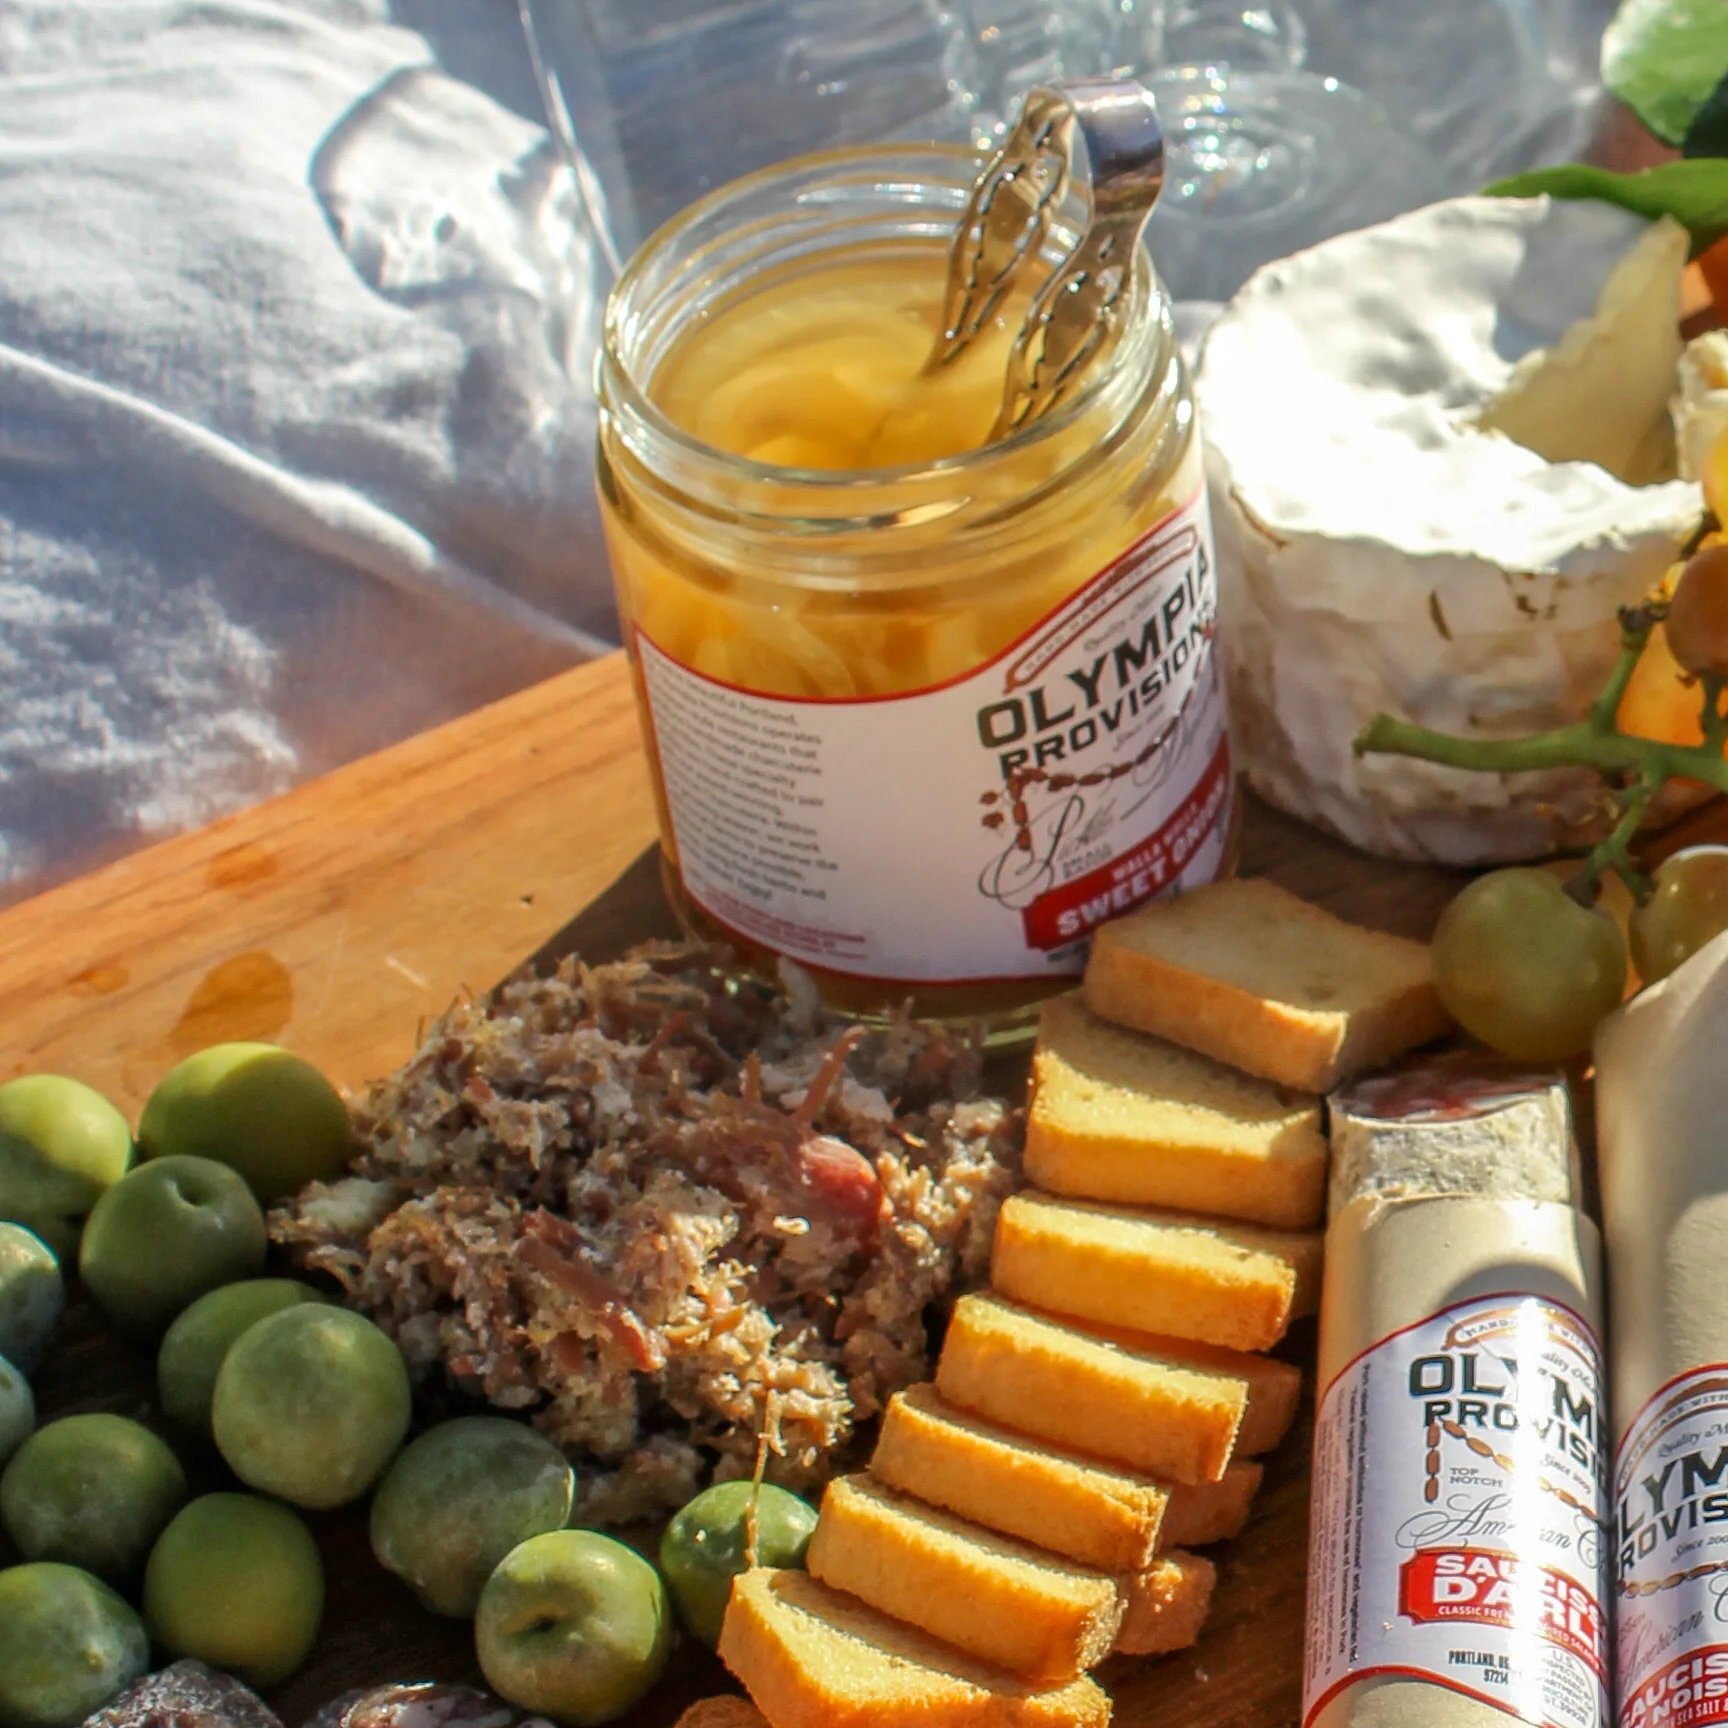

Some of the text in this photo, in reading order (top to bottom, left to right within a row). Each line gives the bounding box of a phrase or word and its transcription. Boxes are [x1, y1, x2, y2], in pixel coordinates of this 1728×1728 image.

[1000, 617, 1213, 779] PROVISION
[1057, 854, 1167, 936] SWEET
[1449, 1467, 1479, 1476] TOP
[1449, 1475, 1504, 1488] NOTCH
[1438, 1605, 1482, 1617] CLASSIC
[1448, 1649, 1497, 1668] PORTLAND,
[1677, 1706, 1694, 1726] SEA
[1695, 1697, 1720, 1718] SALT
